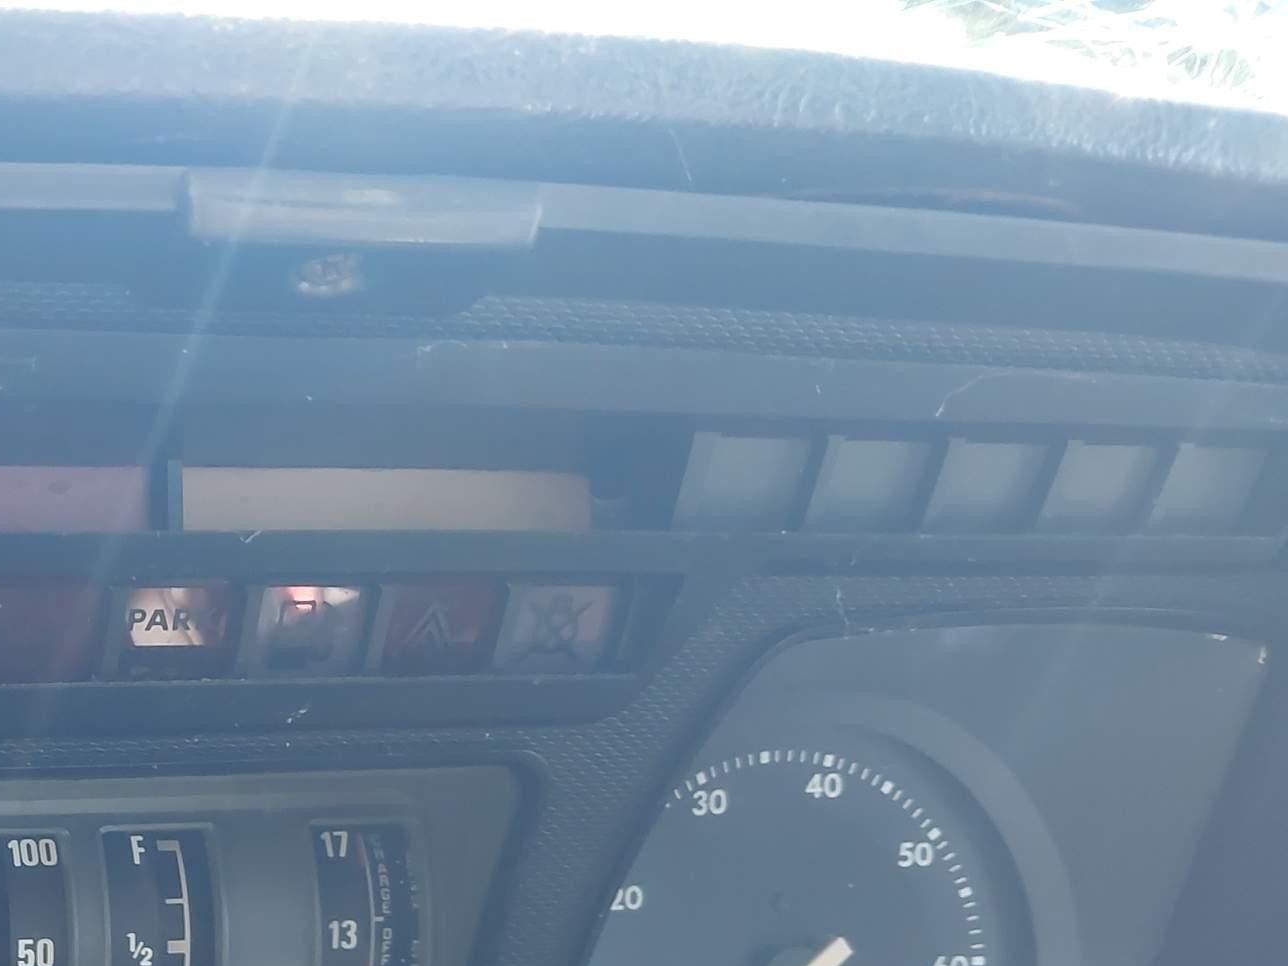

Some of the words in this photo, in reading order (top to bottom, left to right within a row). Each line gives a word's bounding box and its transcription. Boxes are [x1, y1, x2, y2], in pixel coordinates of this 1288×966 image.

[127, 607, 200, 633] PAR
[806, 773, 843, 798] 40
[692, 789, 727, 816] 30
[8, 838, 58, 867] 100
[130, 835, 145, 865] F
[320, 831, 348, 858] 17
[897, 842, 934, 867] 50
[610, 886, 643, 911] 20
[328, 919, 358, 950] 13
